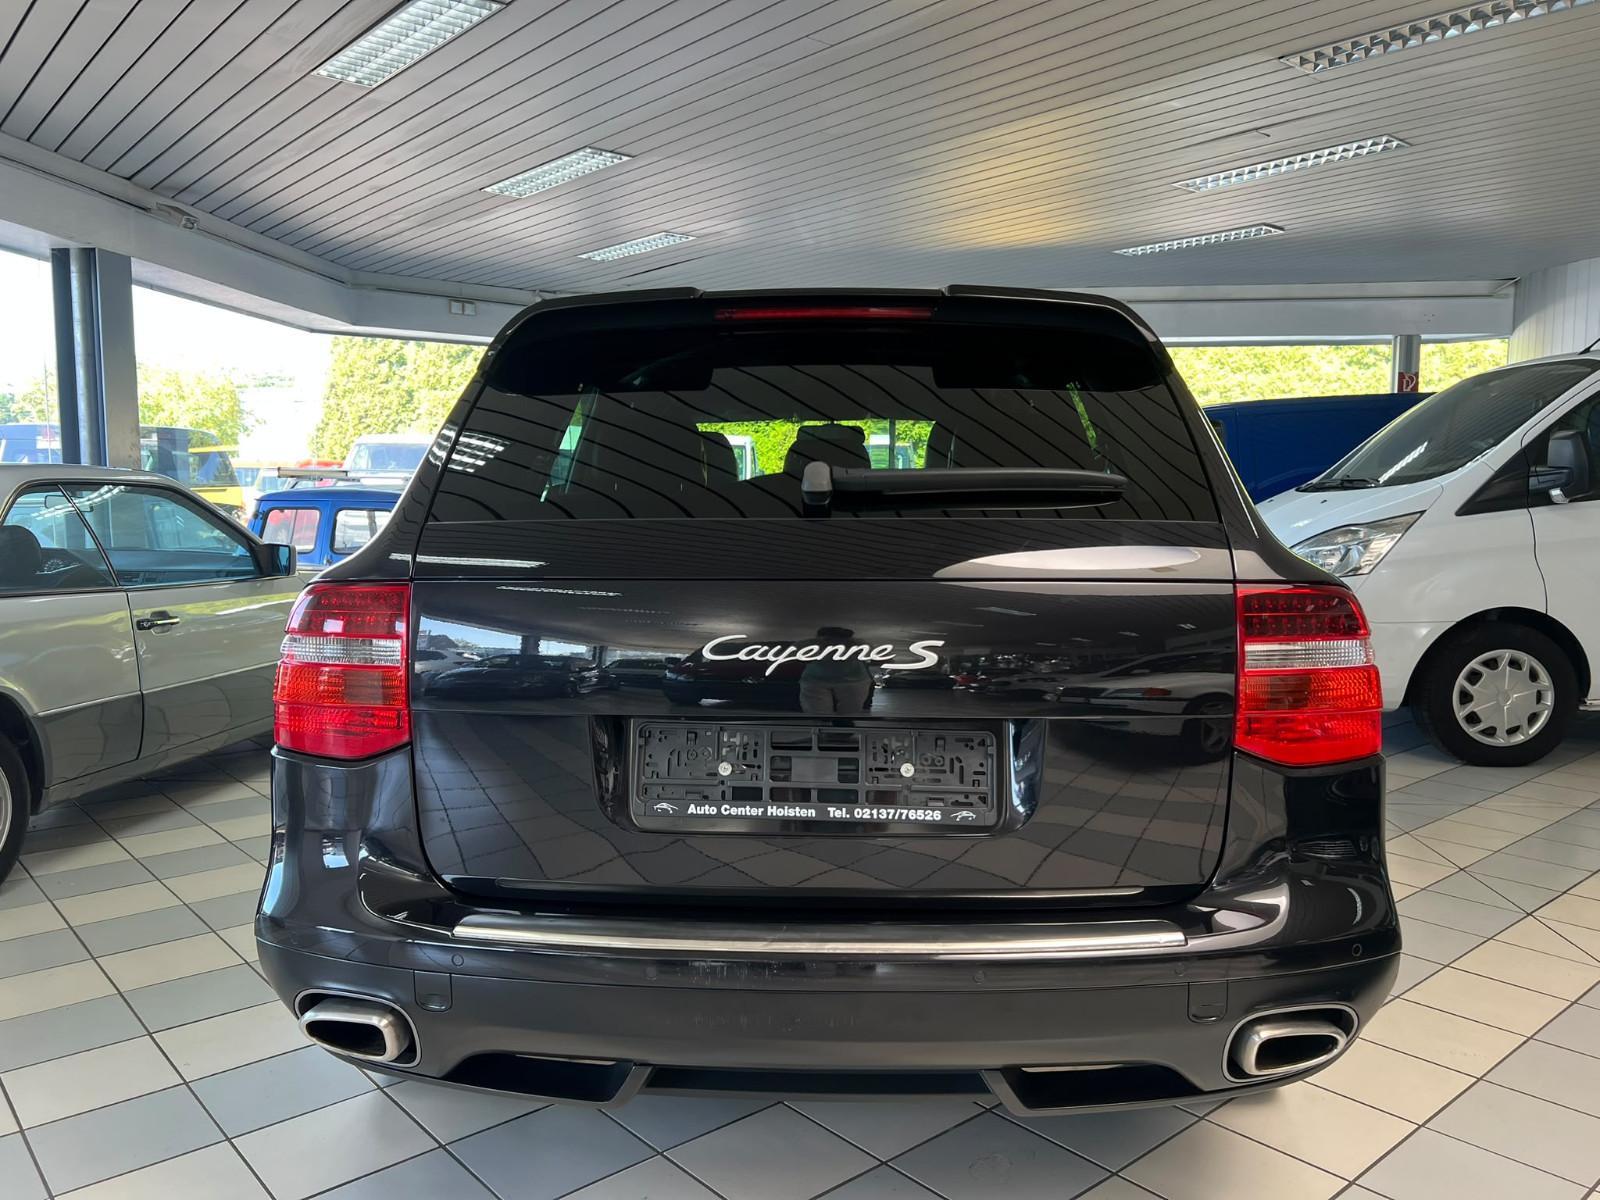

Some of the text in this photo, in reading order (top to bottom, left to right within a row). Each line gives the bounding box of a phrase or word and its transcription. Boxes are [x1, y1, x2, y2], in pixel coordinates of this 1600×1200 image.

[702, 634, 945, 677] Cayenne S
[687, 803, 717, 816] Auto
[720, 804, 764, 817] Center
[827, 807, 850, 819] Tel.
[853, 808, 942, 821] 02137/76526
